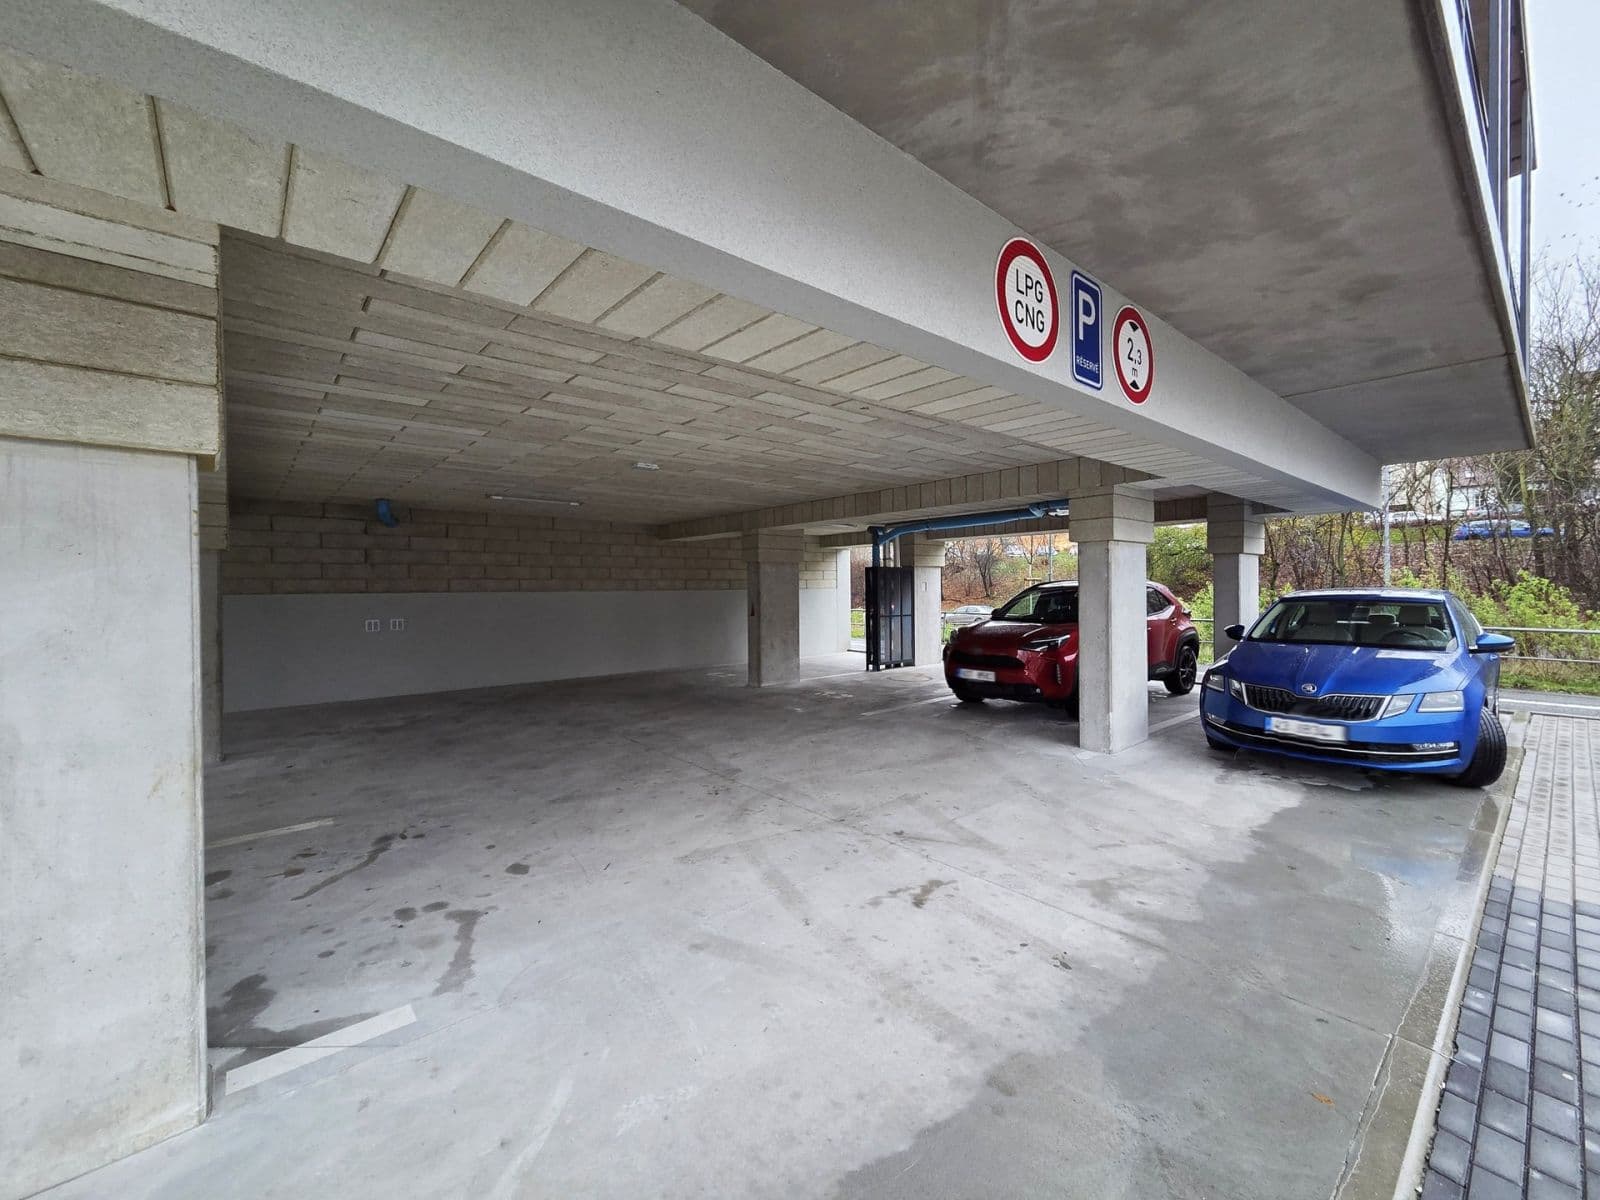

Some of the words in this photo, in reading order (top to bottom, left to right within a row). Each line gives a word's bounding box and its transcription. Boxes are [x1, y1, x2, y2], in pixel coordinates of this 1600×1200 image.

[1015, 268, 1044, 304] LPG
[1015, 300, 1045, 333] CNG
[1078, 289, 1096, 341] P
[1131, 367, 1139, 377] m
